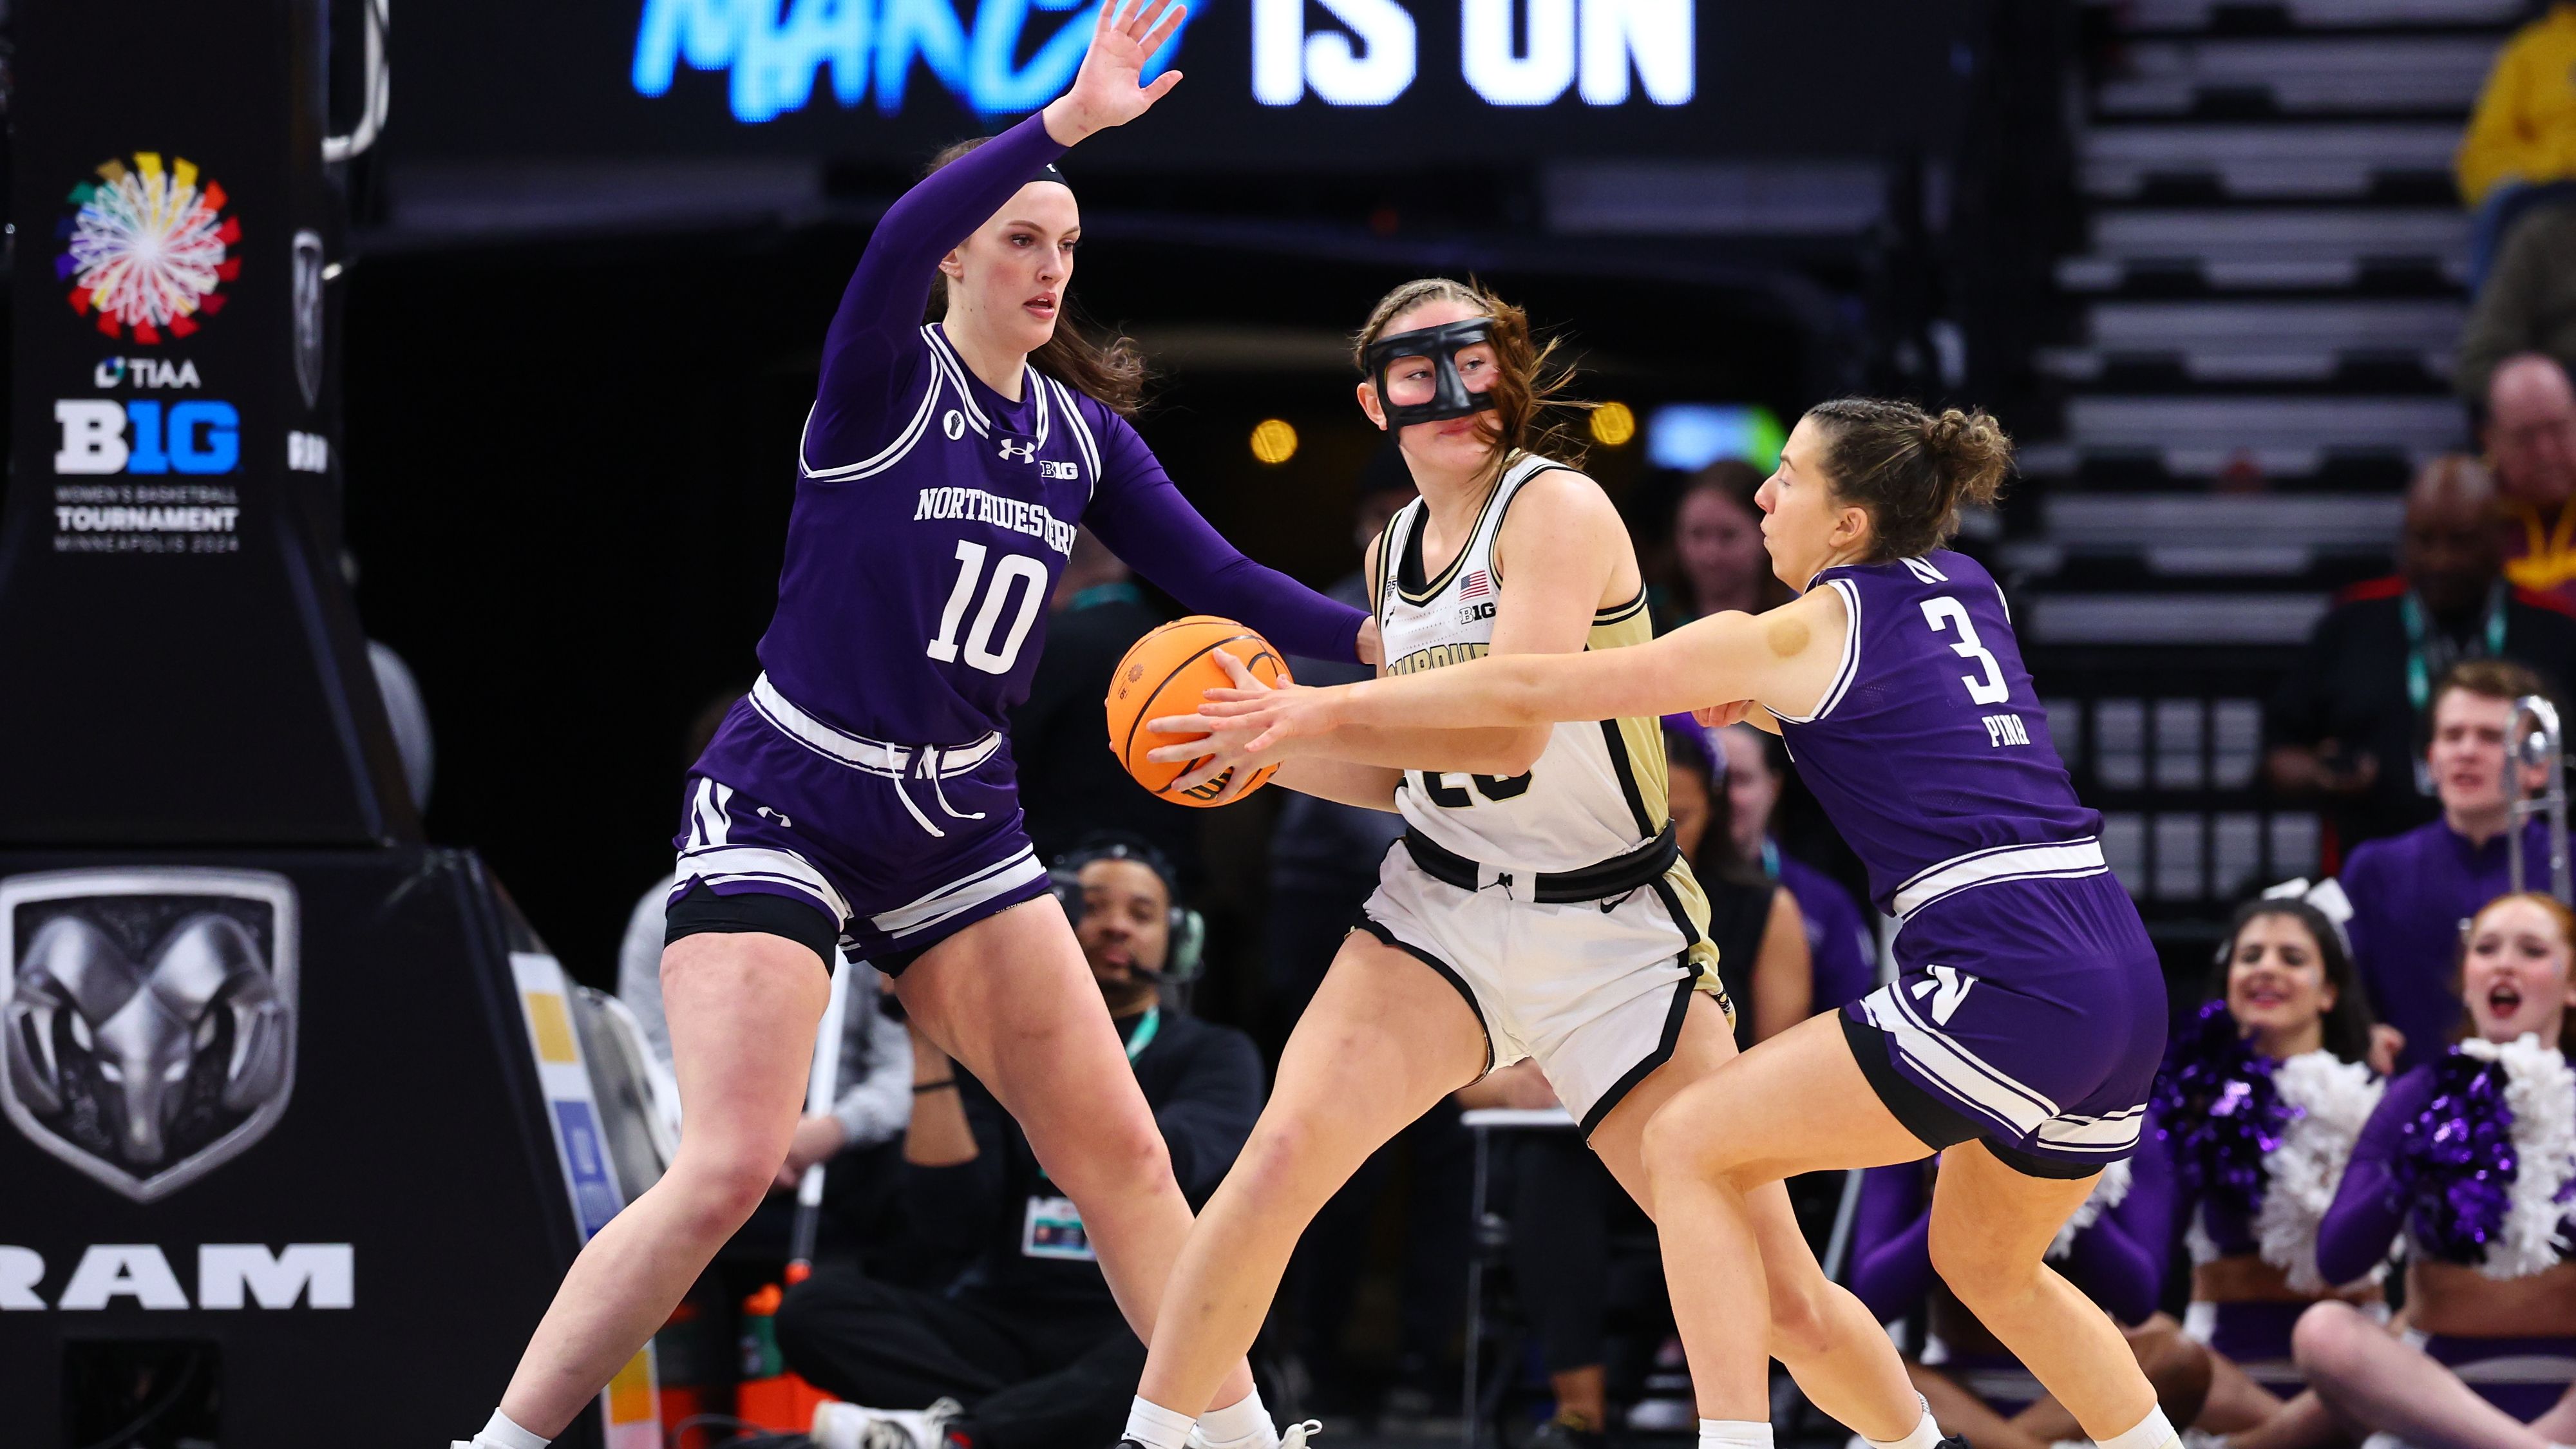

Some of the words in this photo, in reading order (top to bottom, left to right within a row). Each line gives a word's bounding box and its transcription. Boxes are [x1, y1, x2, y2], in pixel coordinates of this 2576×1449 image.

[128, 358, 202, 388] TIAA
[54, 506, 240, 532] TOURNAMENT
[54, 535, 186, 553] MINNEAPOLIS
[926, 539, 1048, 675] 10
[1919, 596, 2009, 705] 3
[1982, 714, 2031, 747] PINA
